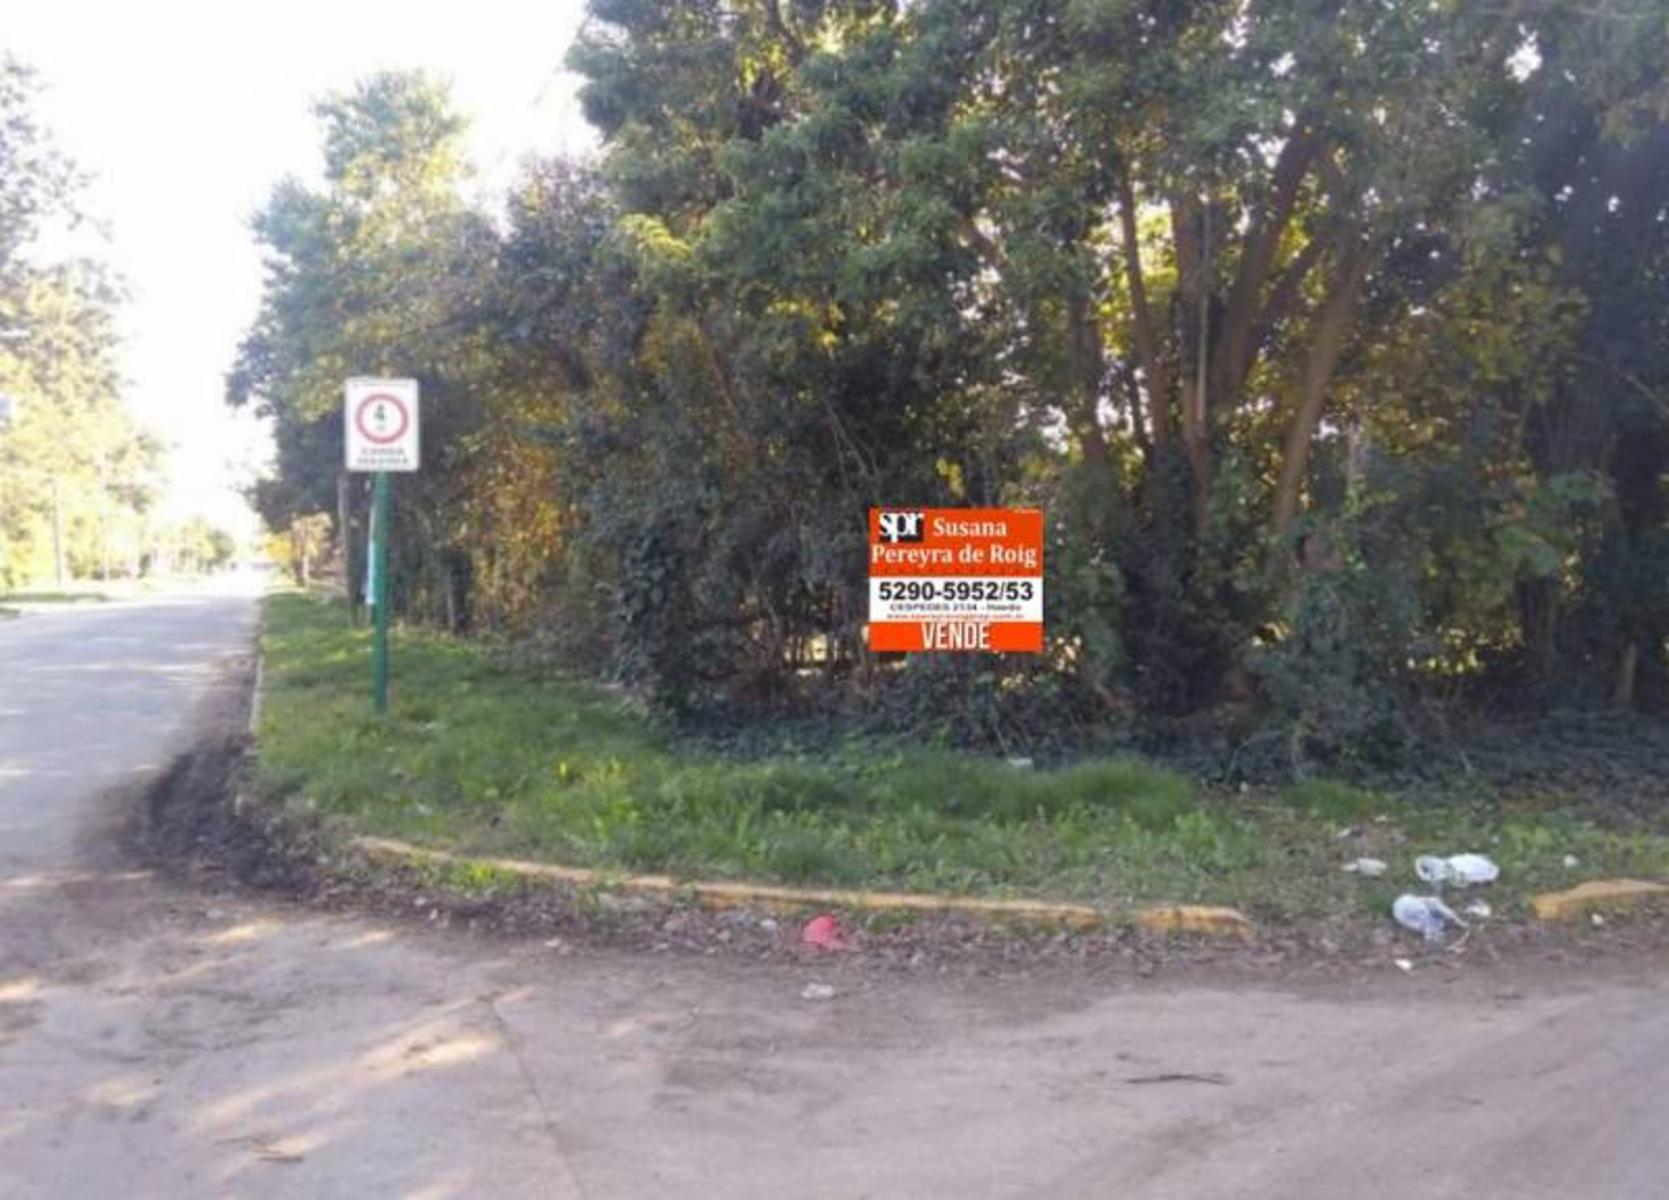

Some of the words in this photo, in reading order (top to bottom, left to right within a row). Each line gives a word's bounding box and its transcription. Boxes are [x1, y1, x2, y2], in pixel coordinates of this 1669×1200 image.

[879, 512, 924, 543] spr
[933, 518, 1007, 537] Susana
[871, 545, 953, 567] Pereyra
[959, 545, 984, 564] de
[990, 544, 1037, 567] Roig
[879, 581, 1034, 601] 5290-5952/53
[921, 622, 990, 649] VENDE
